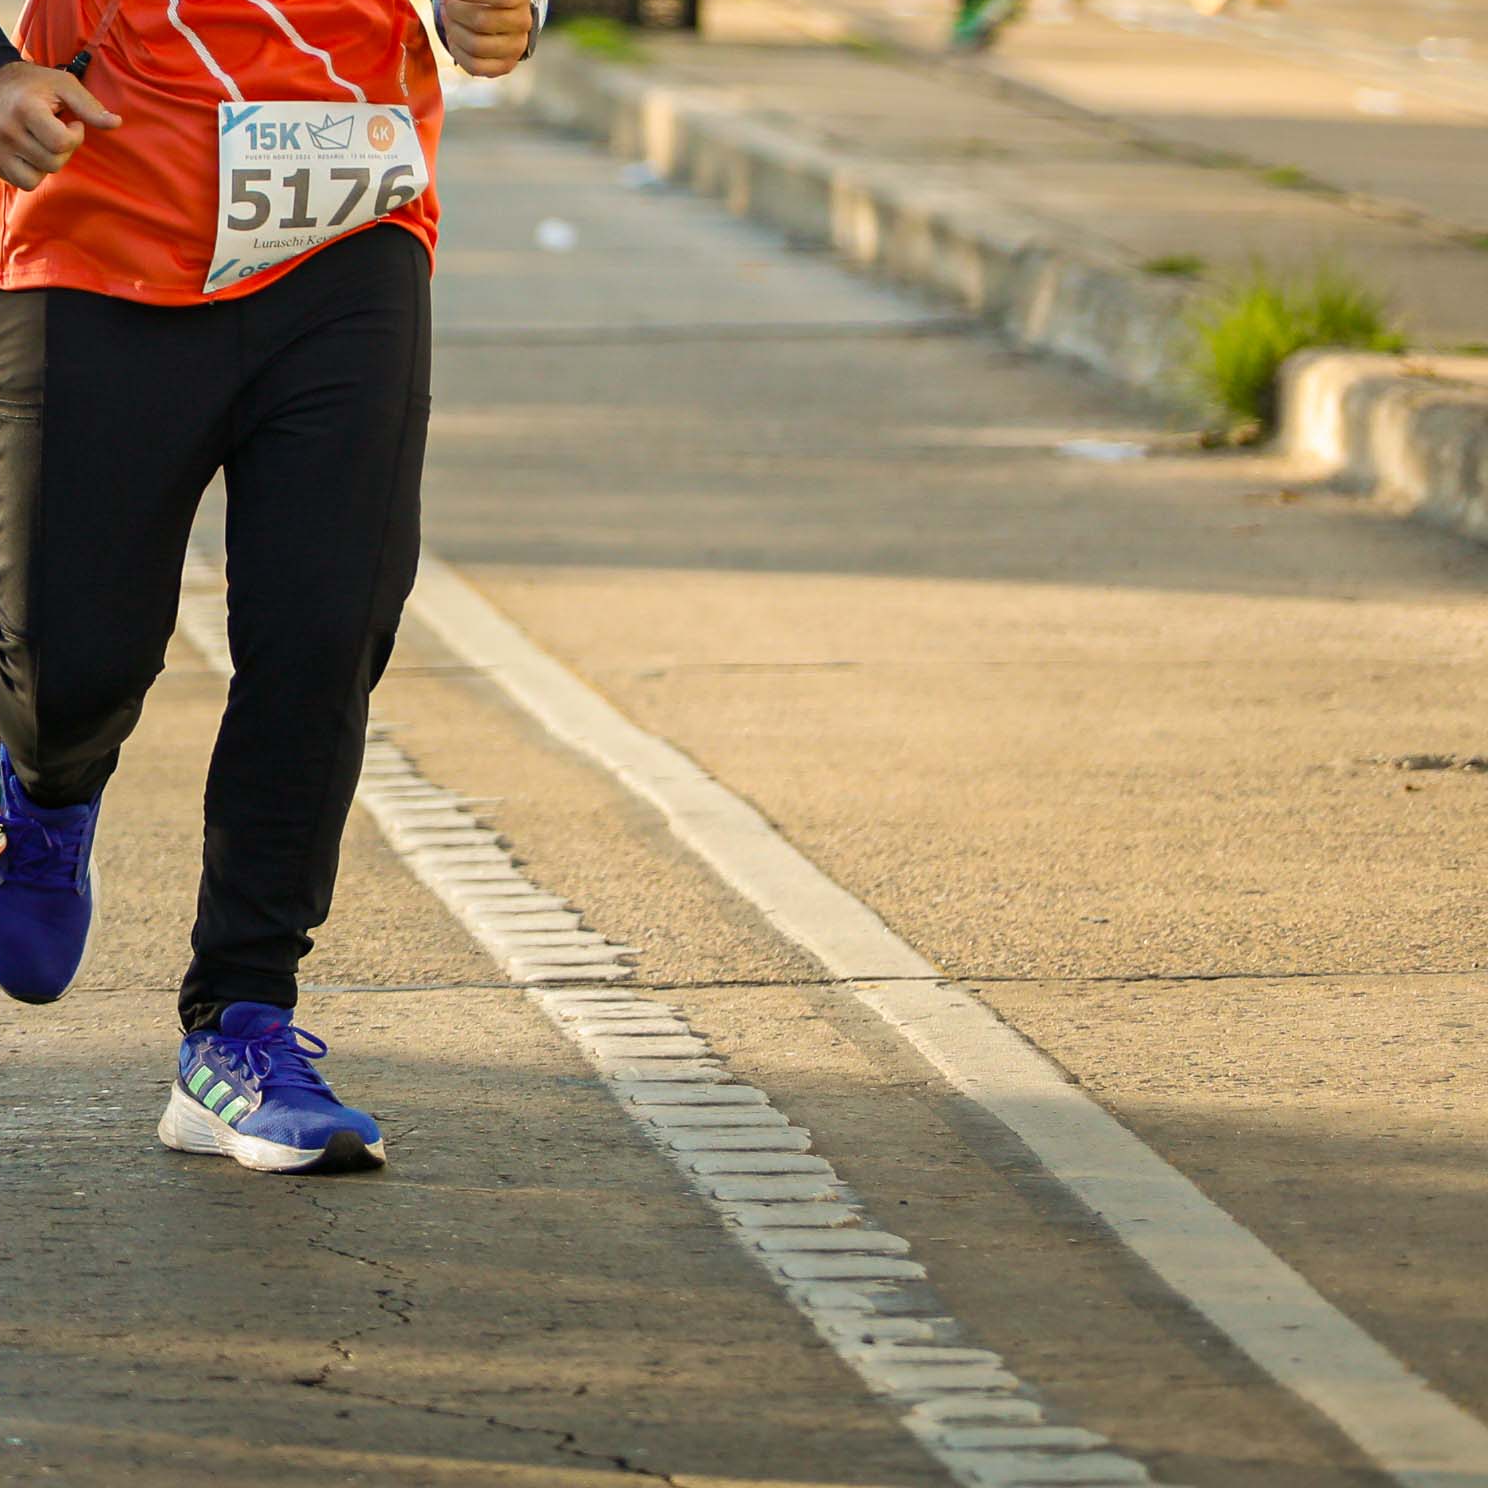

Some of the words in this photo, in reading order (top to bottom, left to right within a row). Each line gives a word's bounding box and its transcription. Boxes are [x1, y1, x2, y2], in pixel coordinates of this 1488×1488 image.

[245, 122, 302, 150] 15K
[372, 125, 390, 141] 4K
[227, 164, 416, 231] 5176
[253, 237, 304, 249] Luraschi
